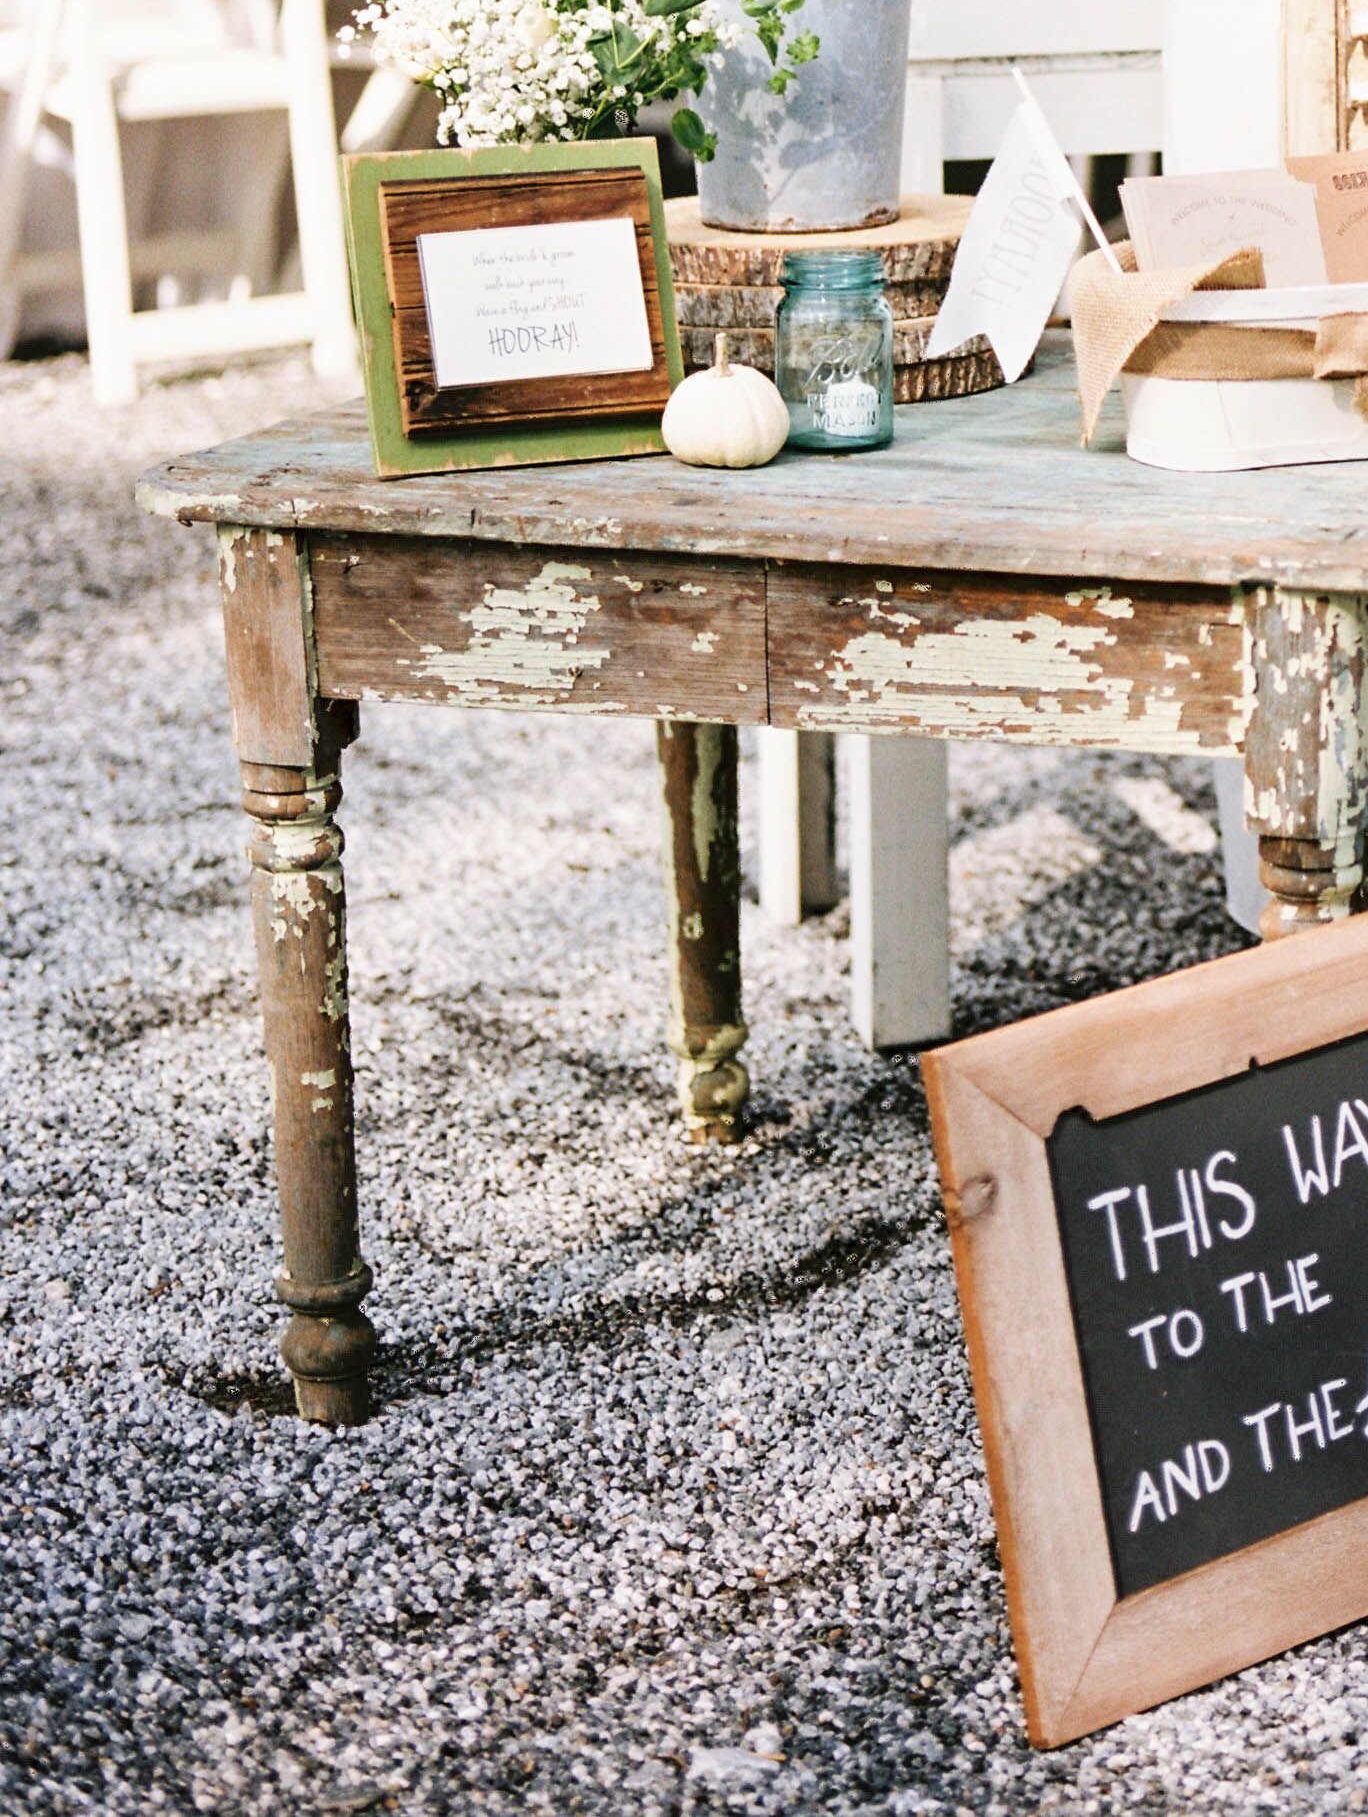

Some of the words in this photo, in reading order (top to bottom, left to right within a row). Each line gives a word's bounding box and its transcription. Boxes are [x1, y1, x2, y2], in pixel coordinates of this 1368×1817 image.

[1171, 197, 1209, 226] WELCOME
[1213, 196, 1226, 206] TO
[1229, 196, 1247, 206] THE
[489, 320, 580, 357] HOORAY!
[812, 410, 878, 430] MASON
[1088, 1149, 1257, 1281] THIS
[1129, 1308, 1202, 1370] TO
[1220, 1252, 1333, 1332] THE
[1129, 1439, 1231, 1533] AND
[1242, 1378, 1352, 1472] THE
